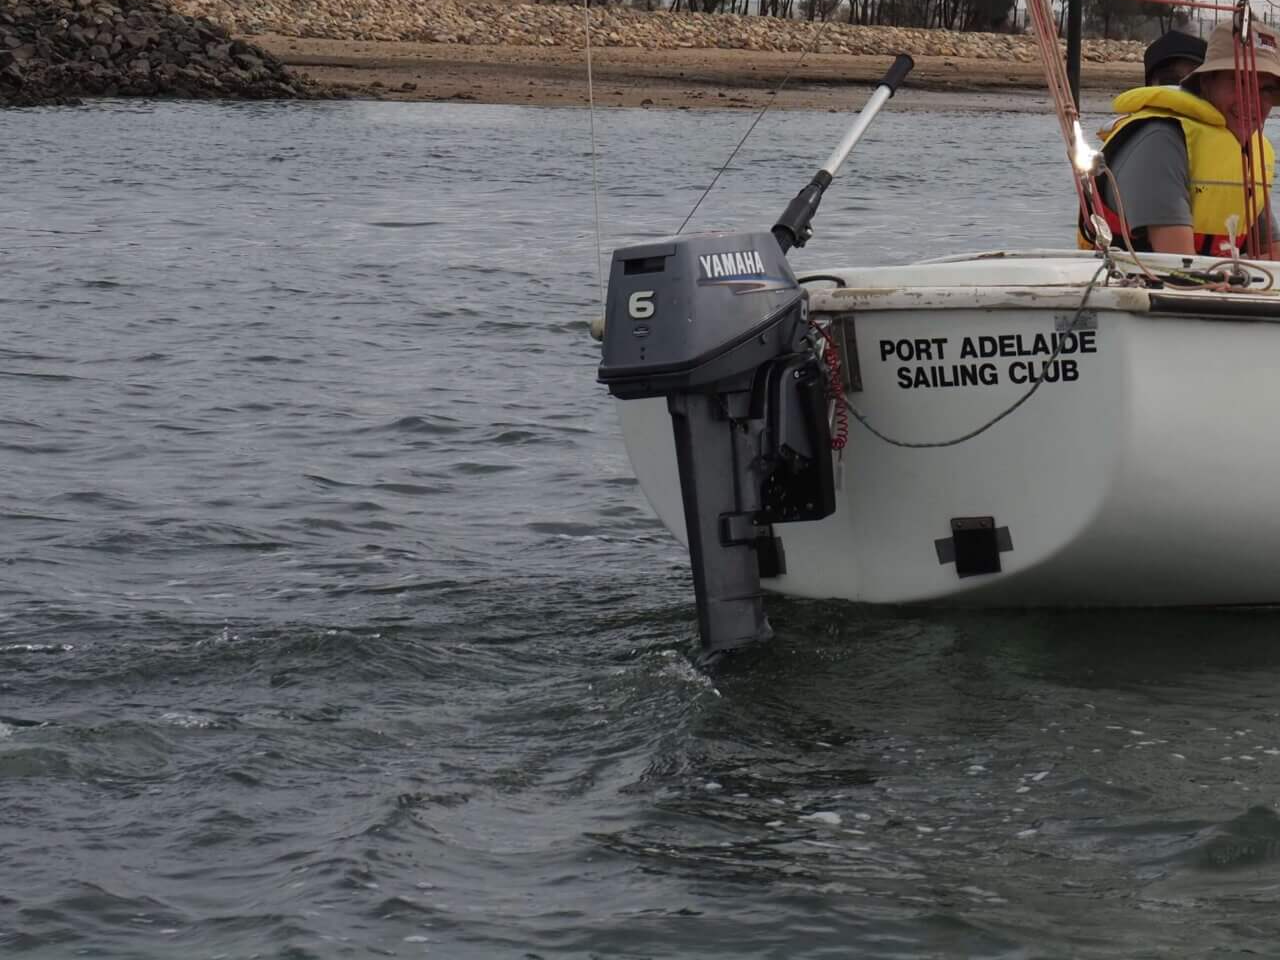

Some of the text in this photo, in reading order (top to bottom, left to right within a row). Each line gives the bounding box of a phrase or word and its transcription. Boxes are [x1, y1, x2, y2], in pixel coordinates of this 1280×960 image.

[700, 251, 765, 278] YAMAHA
[629, 290, 656, 319] 6
[879, 331, 1097, 361] PORT ADELAIDE
[897, 360, 1079, 389] SAILING CLUB
